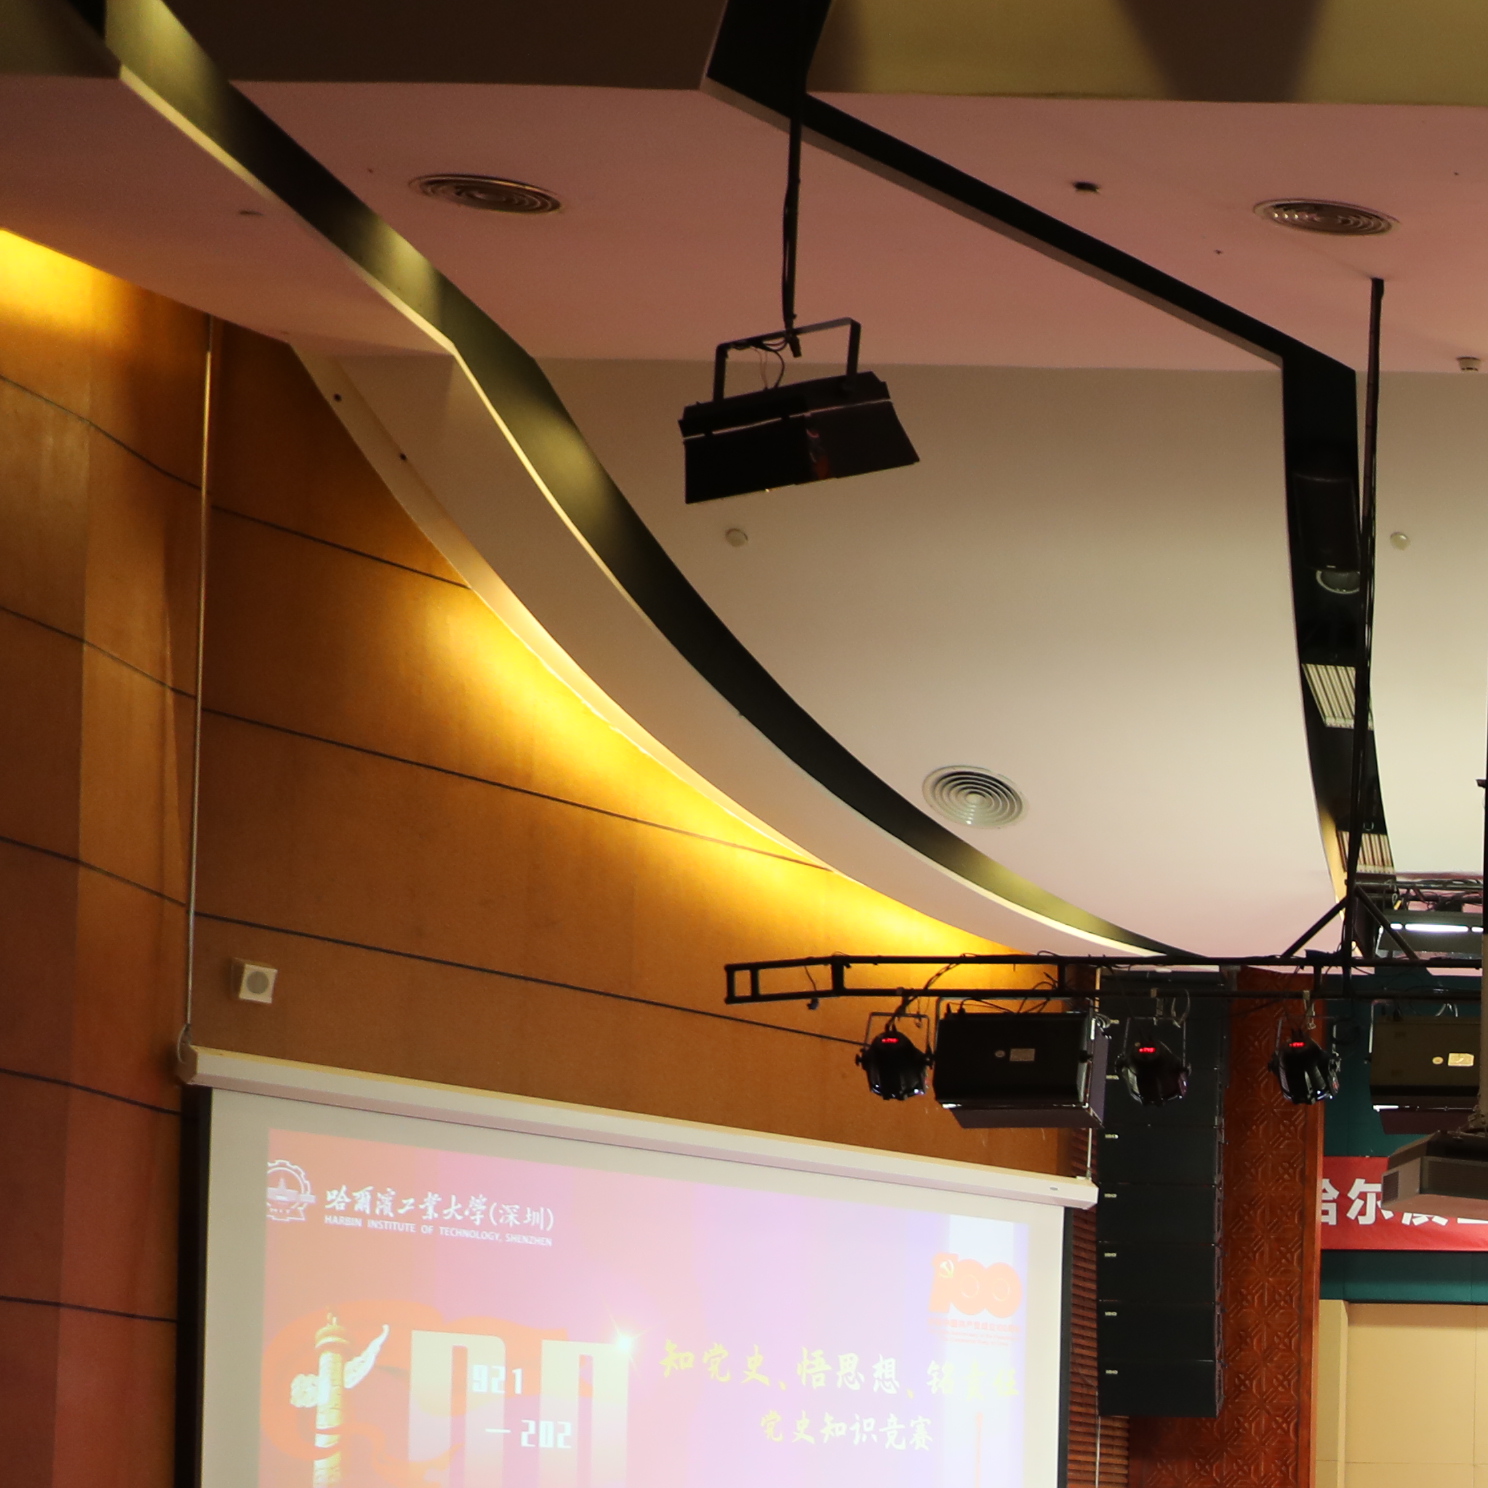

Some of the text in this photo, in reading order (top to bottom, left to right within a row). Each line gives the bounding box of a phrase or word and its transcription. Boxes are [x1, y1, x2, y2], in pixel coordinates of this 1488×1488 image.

[324, 1215, 362, 1227] HARBIN
[367, 1219, 416, 1233] INSTITUTE
[421, 1224, 433, 1234] OF
[505, 1233, 553, 1246] SHENZHEN
[760, 1410, 933, 1451] 党史知识竞赛
